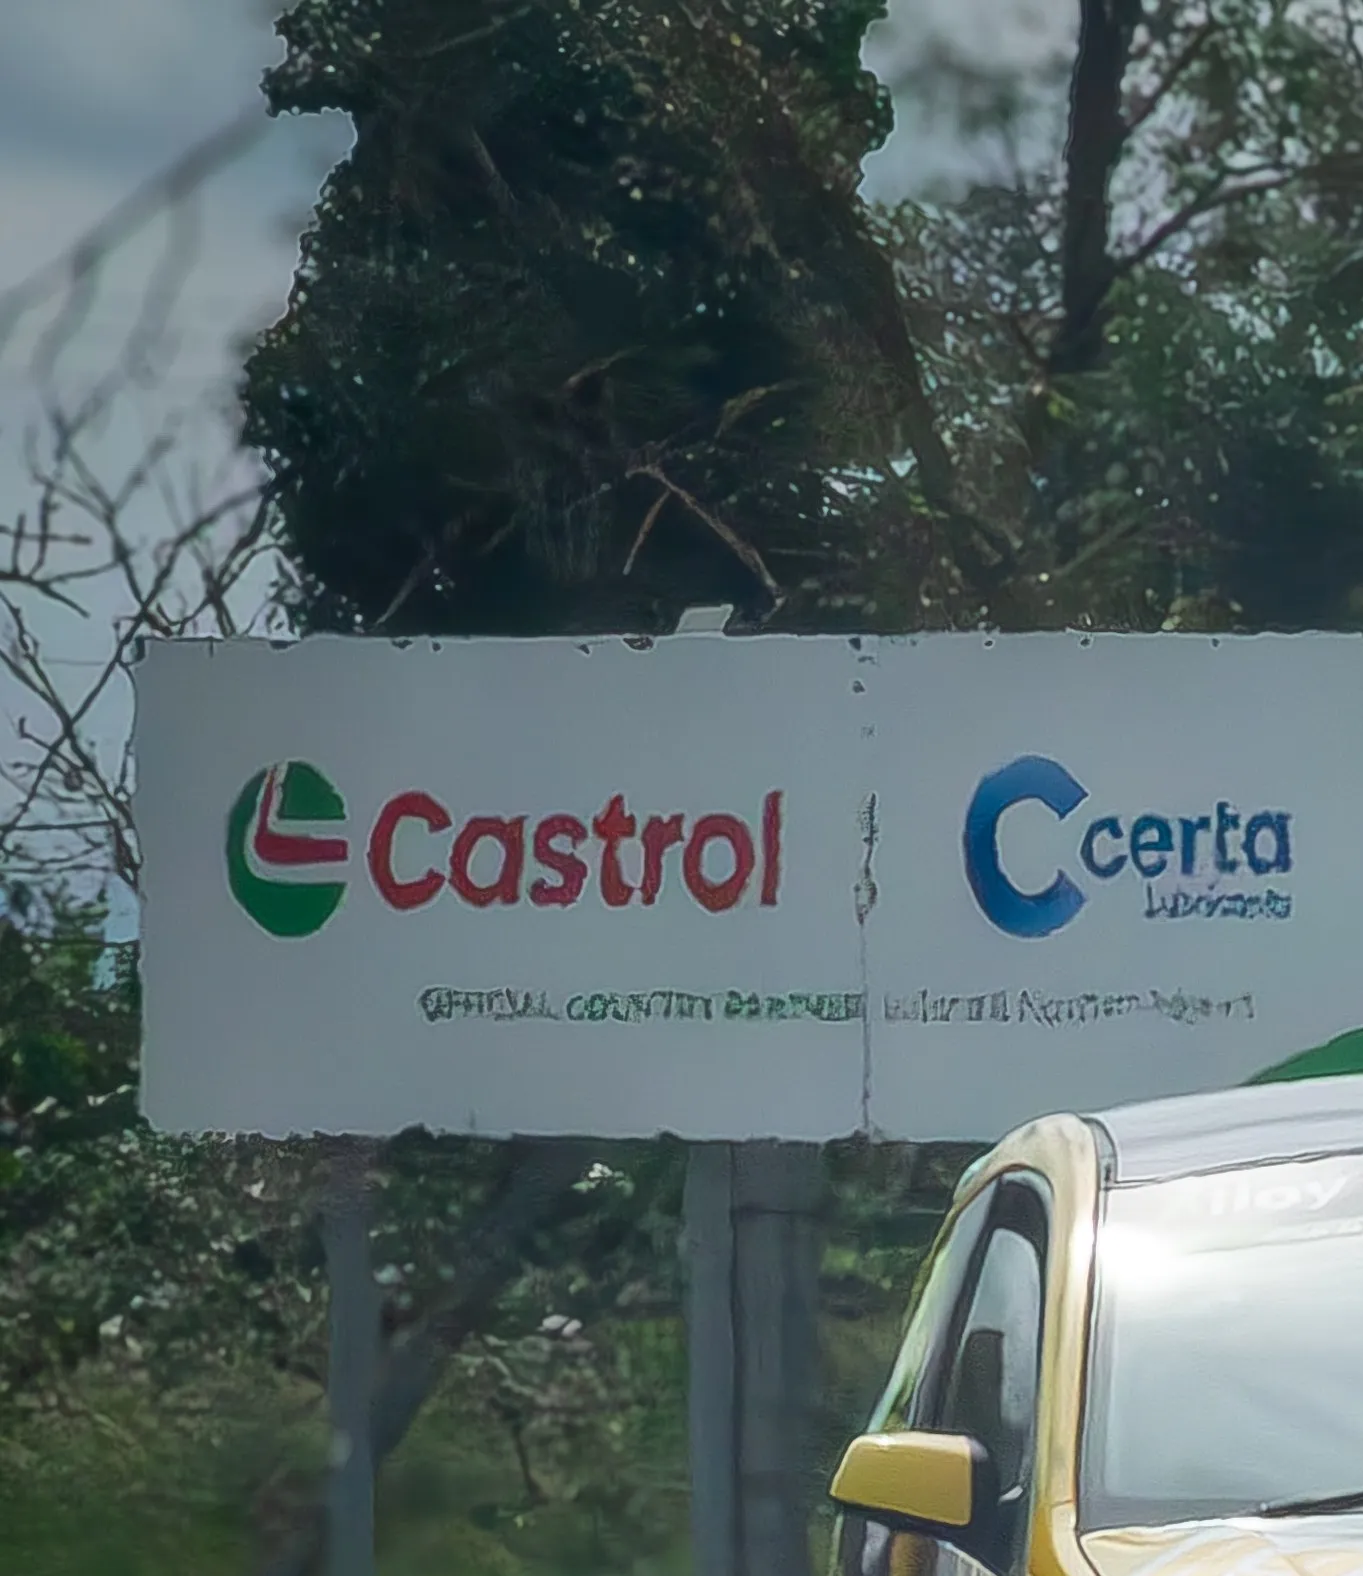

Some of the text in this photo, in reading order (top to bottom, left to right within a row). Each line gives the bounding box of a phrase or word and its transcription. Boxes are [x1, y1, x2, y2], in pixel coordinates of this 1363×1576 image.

[367, 788, 784, 913] Castrol
[1080, 801, 1292, 879] certa
[1168, 1172, 1353, 1216] lloy
